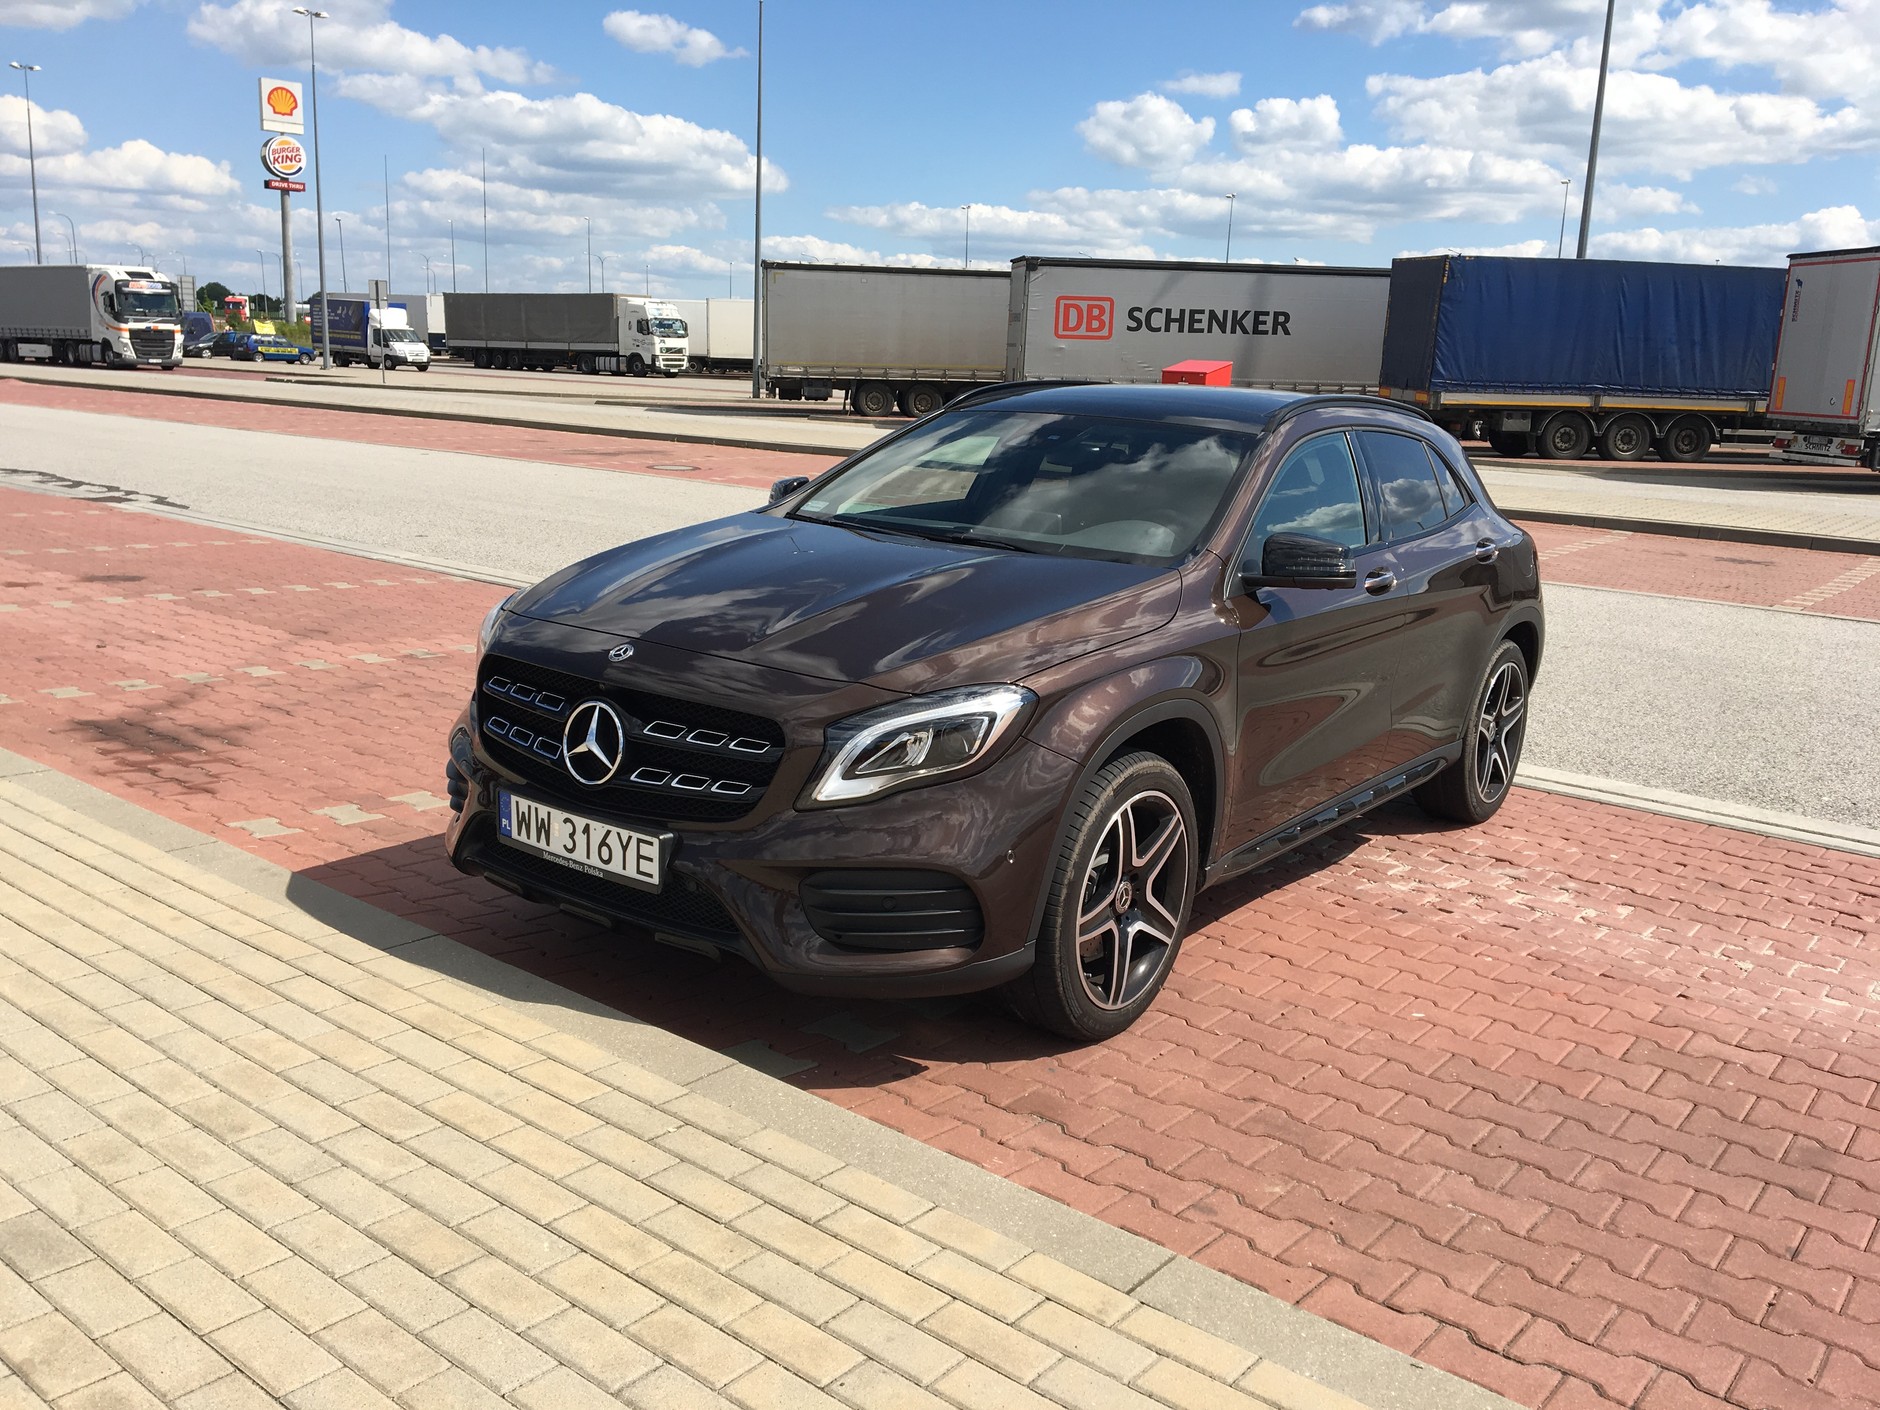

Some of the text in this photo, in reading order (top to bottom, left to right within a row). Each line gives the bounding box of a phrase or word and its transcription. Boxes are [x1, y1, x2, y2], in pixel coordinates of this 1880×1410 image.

[271, 146, 301, 156] BURGER
[272, 153, 302, 166] KING
[271, 180, 288, 188] DRIVE
[1062, 302, 1292, 336] DB SCHENKER
[502, 818, 511, 831] PL
[515, 800, 654, 879] WW 316YE
[542, 851, 604, 878] Mercedes-Benz Polska
